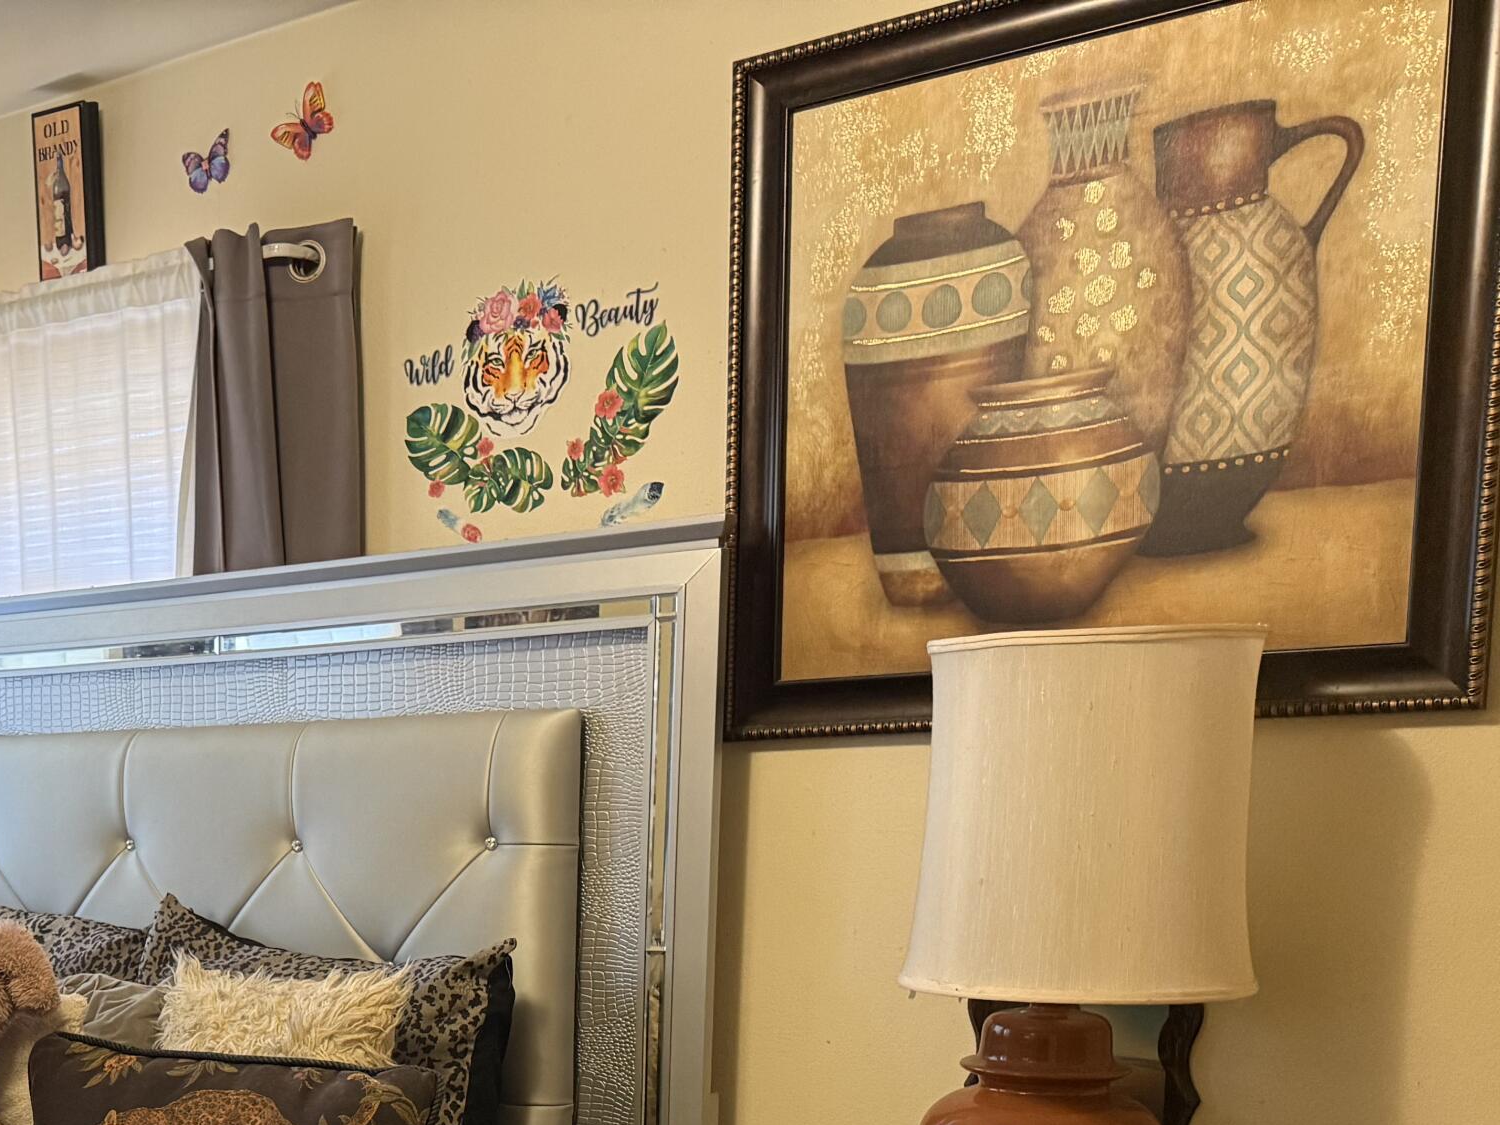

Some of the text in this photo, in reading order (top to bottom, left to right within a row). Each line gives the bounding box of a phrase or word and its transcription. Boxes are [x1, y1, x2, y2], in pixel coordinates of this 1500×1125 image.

[43, 119, 70, 139] OLD
[38, 139, 78, 162] BRANDY
[404, 282, 659, 386] Wild Beauty
